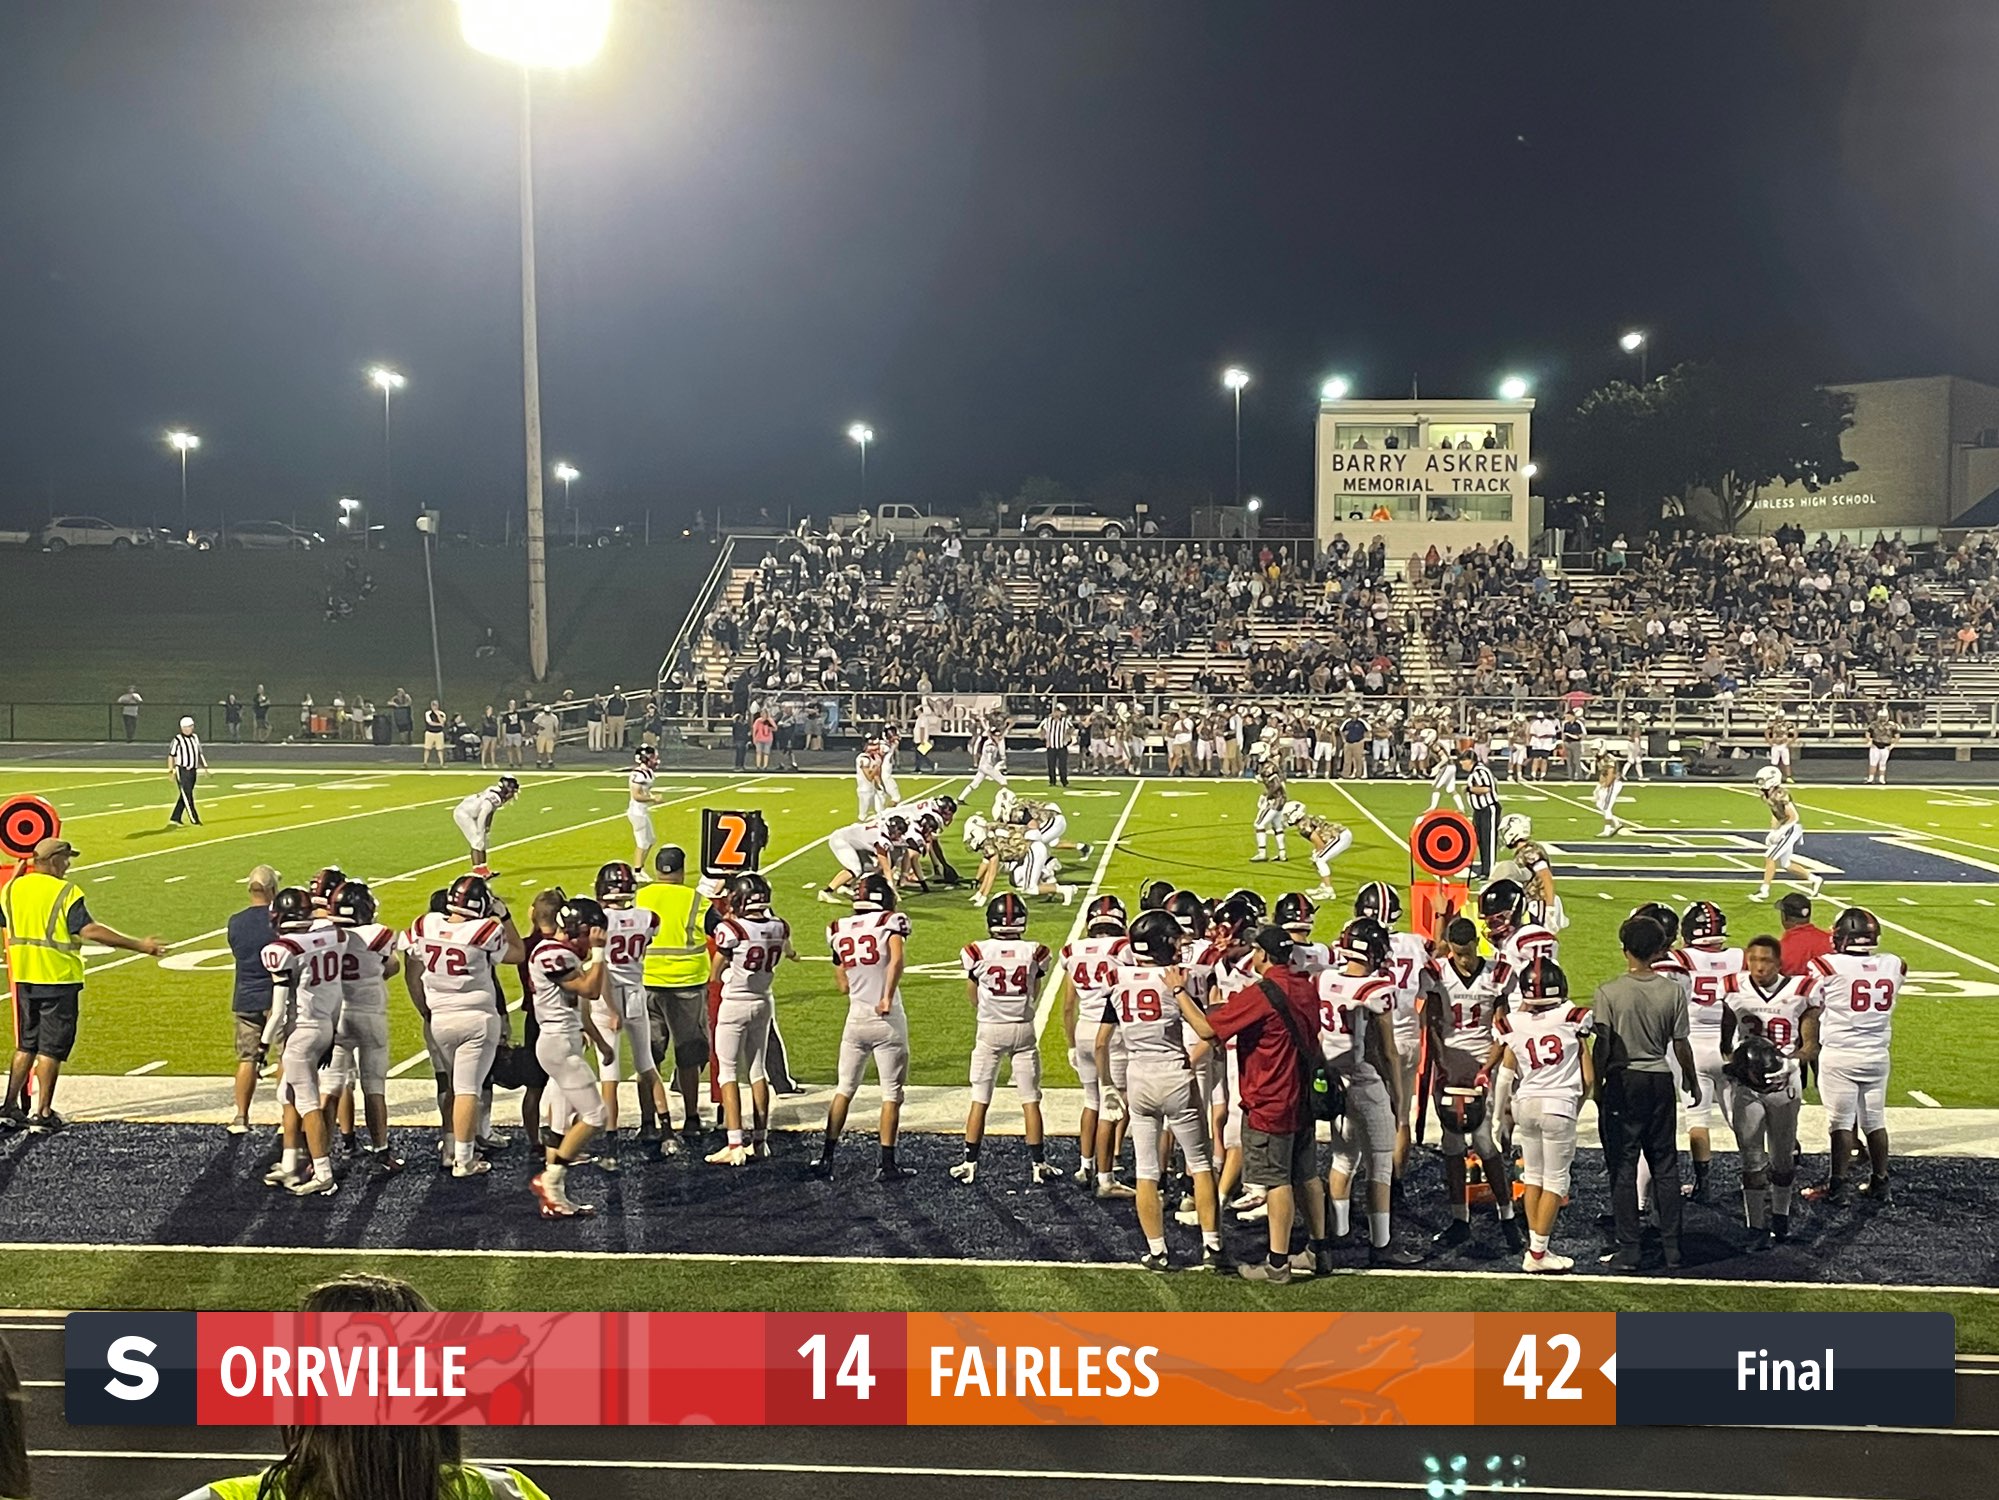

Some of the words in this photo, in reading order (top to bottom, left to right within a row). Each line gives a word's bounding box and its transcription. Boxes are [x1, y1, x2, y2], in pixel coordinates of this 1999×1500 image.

[1333, 454, 1407, 472] BARRY
[1425, 454, 1518, 472] ASKREN
[1344, 478, 1434, 492] MEMORIAL
[1452, 478, 1510, 492] TRACK
[1801, 496, 1827, 507] HIGH
[1832, 494, 1876, 506] SCHOOL
[715, 815, 747, 865] 2
[263, 952, 278, 969] 10
[425, 944, 471, 976] 72
[609, 934, 645, 965] 20
[743, 945, 782, 973] 80
[838, 935, 880, 967] 23
[310, 950, 339, 987] 10
[987, 965, 1028, 996] 34
[1121, 989, 1163, 1023] 19
[1851, 979, 1894, 1012] 63
[1319, 1000, 1355, 1035] 31
[1451, 1003, 1482, 1030] 11
[1525, 1036, 1565, 1071] 13
